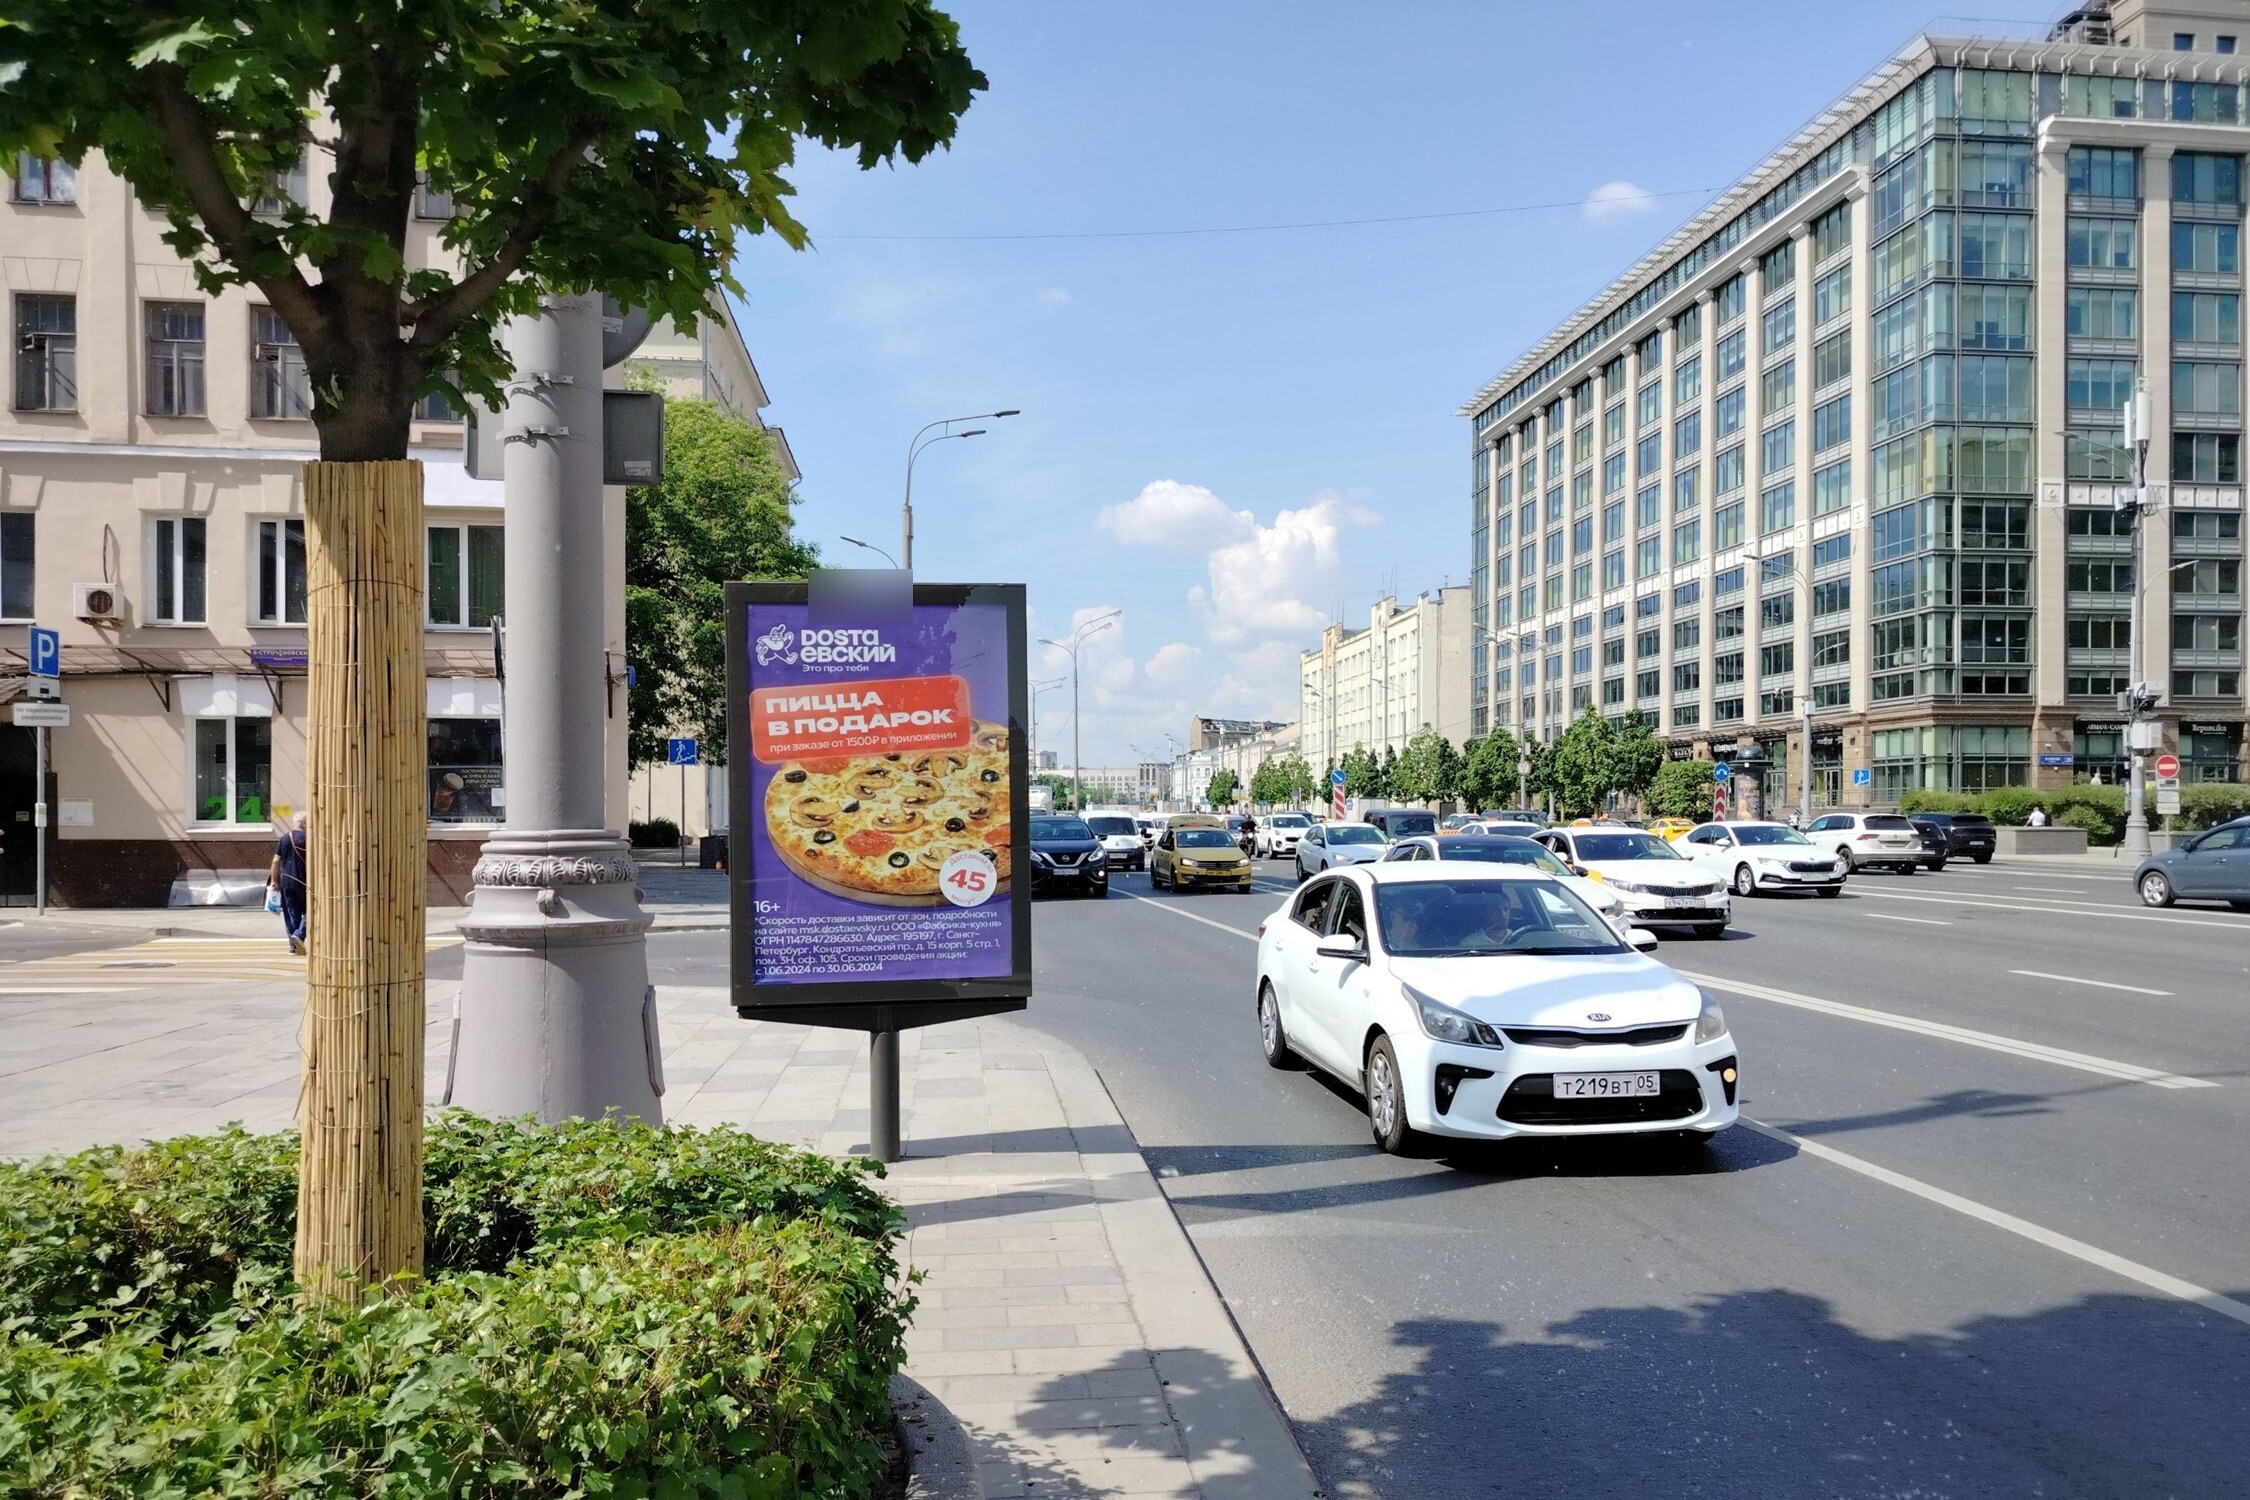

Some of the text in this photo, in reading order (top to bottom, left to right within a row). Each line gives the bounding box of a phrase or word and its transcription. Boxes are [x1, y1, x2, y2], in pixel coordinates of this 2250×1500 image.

[38, 633, 54, 670] P
[802, 664, 870, 674] Это про тебя
[766, 692, 884, 714] ПИЦЦА
[768, 708, 954, 736] В ПОДАРОК
[770, 744, 790, 754] при
[792, 742, 830, 752] заказе
[832, 740, 844, 748] от
[890, 732, 956, 744] приложении
[948, 868, 986, 892] 45
[753, 900, 780, 912] 16+
[808, 915, 854, 924] доставки
[856, 914, 896, 922] зависит
[932, 910, 998, 920] подробности
[768, 926, 798, 934] сайте
[800, 923, 890, 934] msk.dostaevsky.ru
[891, 922, 916, 930] ООО
[755, 936, 784, 945] ОГРН
[812, 943, 896, 954] Кондратьевский
[926, 942, 937, 950] 15
[966, 940, 973, 948] 5
[756, 958, 778, 966] пом.
[798, 956, 817, 966] оф.
[840, 954, 872, 964] Сроки
[874, 952, 934, 962] проведения
[763, 964, 811, 975] 1.06.2024
[826, 962, 883, 973] 30.06.2024
[1637, 1075, 1654, 1089] 05
